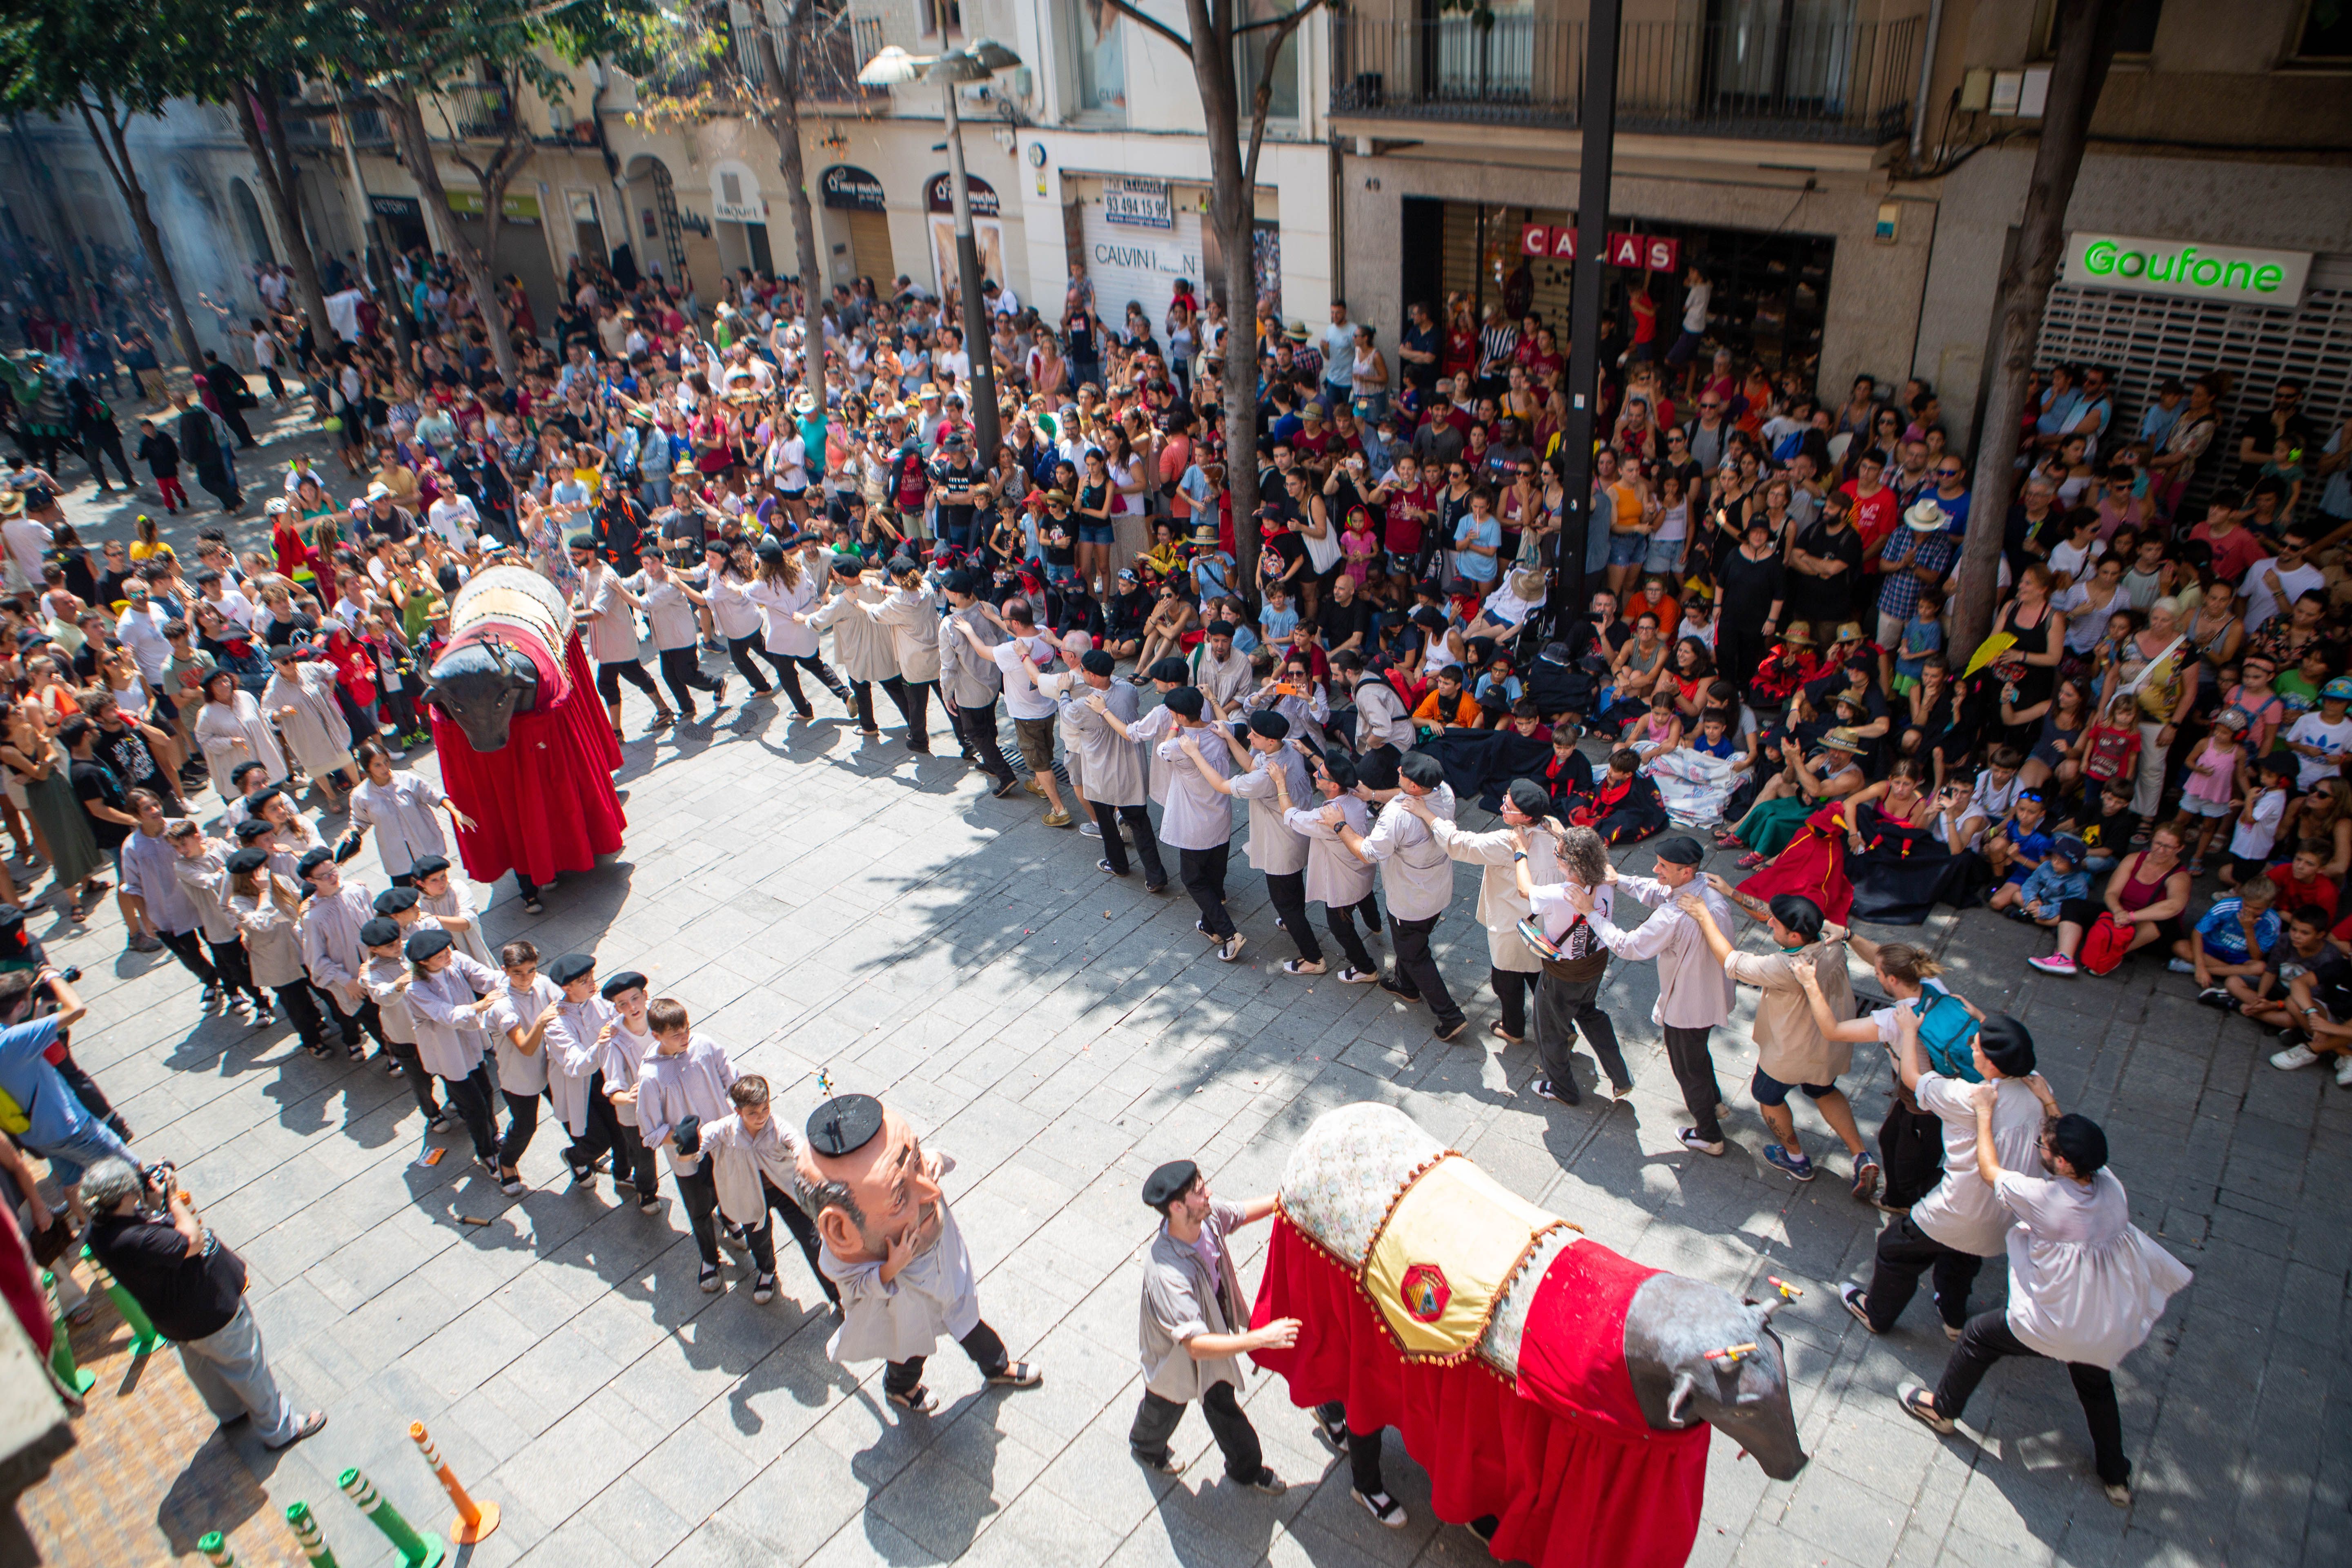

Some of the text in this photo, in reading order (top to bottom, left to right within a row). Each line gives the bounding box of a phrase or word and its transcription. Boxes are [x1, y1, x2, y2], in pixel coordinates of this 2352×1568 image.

[840, 181, 882, 196] muy mucho
[1365, 177, 1380, 190] 49
[968, 189, 997, 203] mucho
[1107, 195, 1118, 213] 93
[1122, 197, 1138, 214] 494
[1142, 199, 1152, 216] 15
[1096, 244, 1148, 270] CALVIN
[1526, 228, 1669, 268] CAAS
[2085, 241, 2285, 292] Goufone
